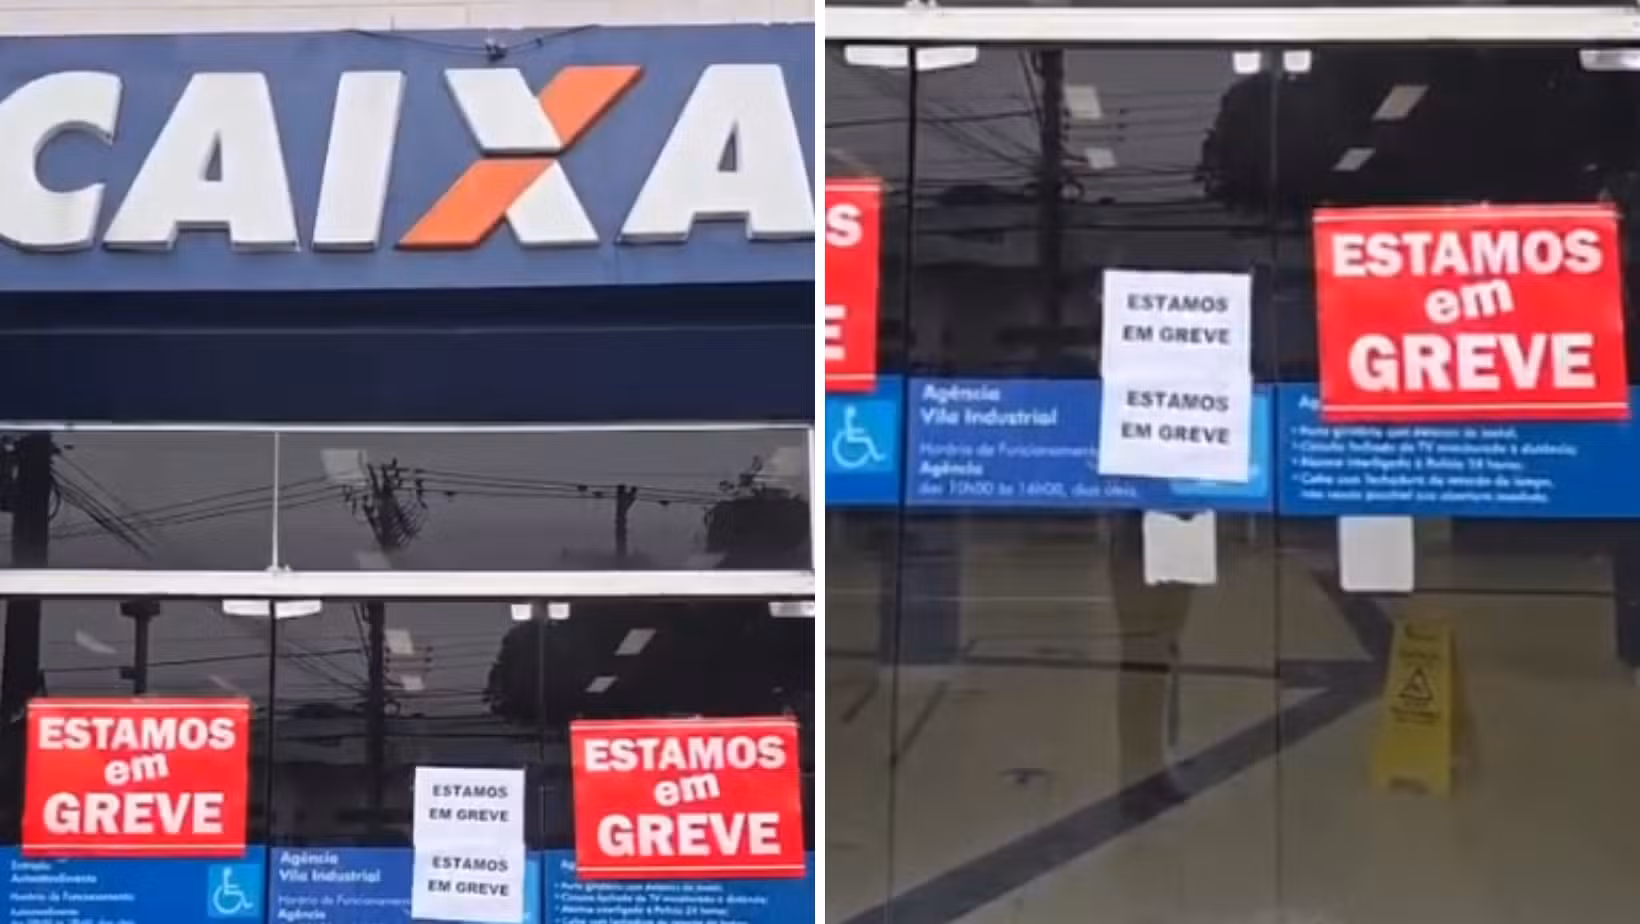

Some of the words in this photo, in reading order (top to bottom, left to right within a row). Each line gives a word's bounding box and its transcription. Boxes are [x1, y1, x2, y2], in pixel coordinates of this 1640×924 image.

[0, 64, 814, 252] CAIXA
[1332, 229, 1604, 278] ESTAMOS
[1127, 294, 1229, 313] ESTAMOS
[1424, 279, 1515, 325] em
[1122, 325, 1153, 341] EM
[1159, 326, 1230, 344] GREVE
[1348, 332, 1597, 393] GREVE
[922, 383, 1001, 404] Agência
[1126, 390, 1229, 412] ESTAMOS
[920, 408, 960, 426] Vila
[964, 407, 1058, 427] Industrial
[1120, 422, 1152, 440] EM
[1158, 424, 1230, 445] GREVE
[919, 460, 984, 478] Agência
[38, 716, 236, 751] ESTAMOS
[584, 735, 788, 772] ESTAMOS
[104, 752, 170, 786] em
[432, 784, 509, 799] ESTAMOS
[653, 771, 721, 808] em
[43, 791, 225, 835] GREVE
[428, 807, 452, 820] EM
[456, 808, 510, 822] GREVE
[597, 811, 782, 857] GREVE
[280, 851, 338, 866] Agência
[431, 856, 509, 872] ESTAMOS
[279, 868, 308, 882] Vila
[311, 868, 381, 882] Industrial
[427, 879, 450, 892] EM
[455, 881, 510, 897] GREVE
